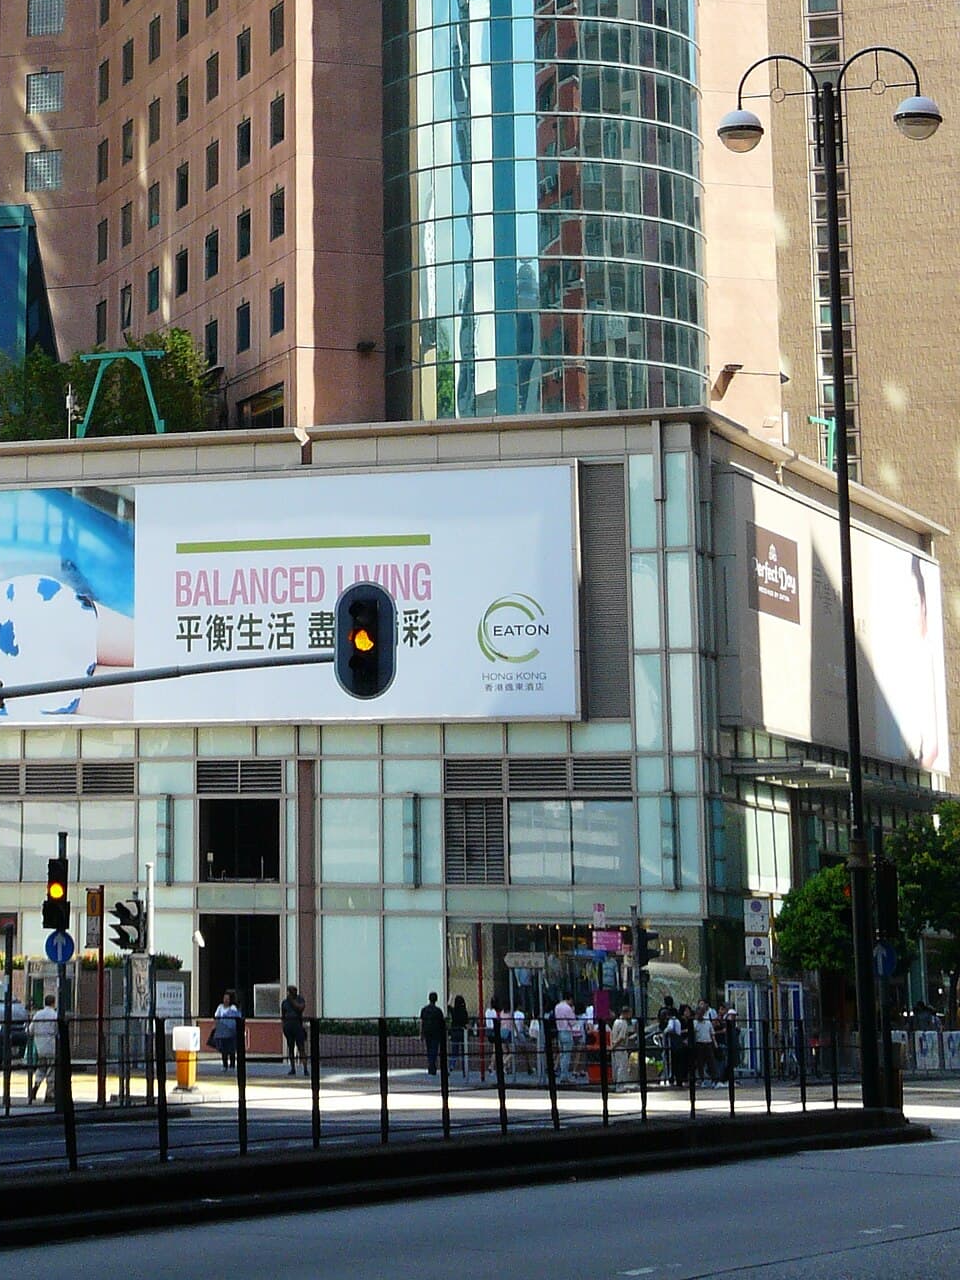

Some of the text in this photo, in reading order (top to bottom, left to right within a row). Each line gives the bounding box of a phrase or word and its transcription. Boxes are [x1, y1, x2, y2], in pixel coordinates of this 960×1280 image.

[175, 566, 325, 608] BALANCED
[778, 566, 796, 594] Day
[176, 608, 432, 652] 平衡生活 盡彩
[493, 624, 549, 636] EATON
[482, 671, 547, 681] HONG KONG
